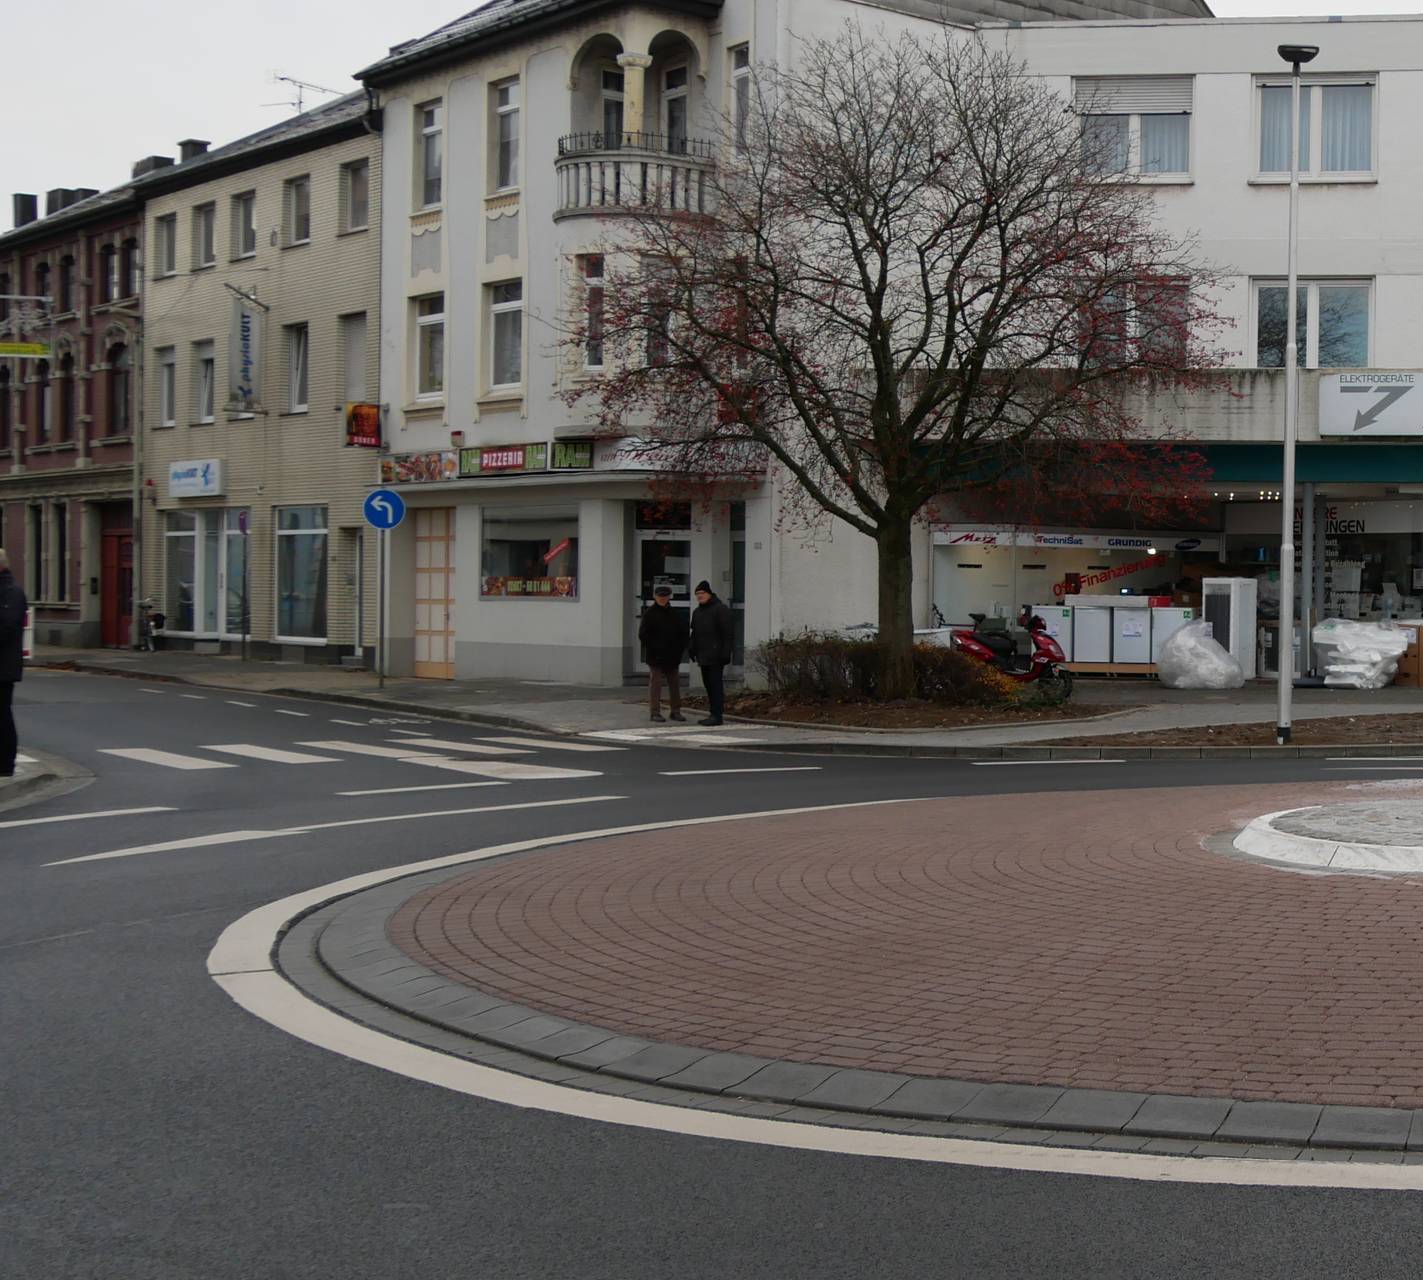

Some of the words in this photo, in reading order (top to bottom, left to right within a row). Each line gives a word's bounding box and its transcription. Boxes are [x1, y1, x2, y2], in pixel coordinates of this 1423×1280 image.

[1339, 374, 1415, 384] ELEKTROGERÄTE
[482, 451, 523, 466] PIZZERIA
[1038, 535, 1083, 546] TechniSat
[1107, 538, 1152, 548] GRUNDIG
